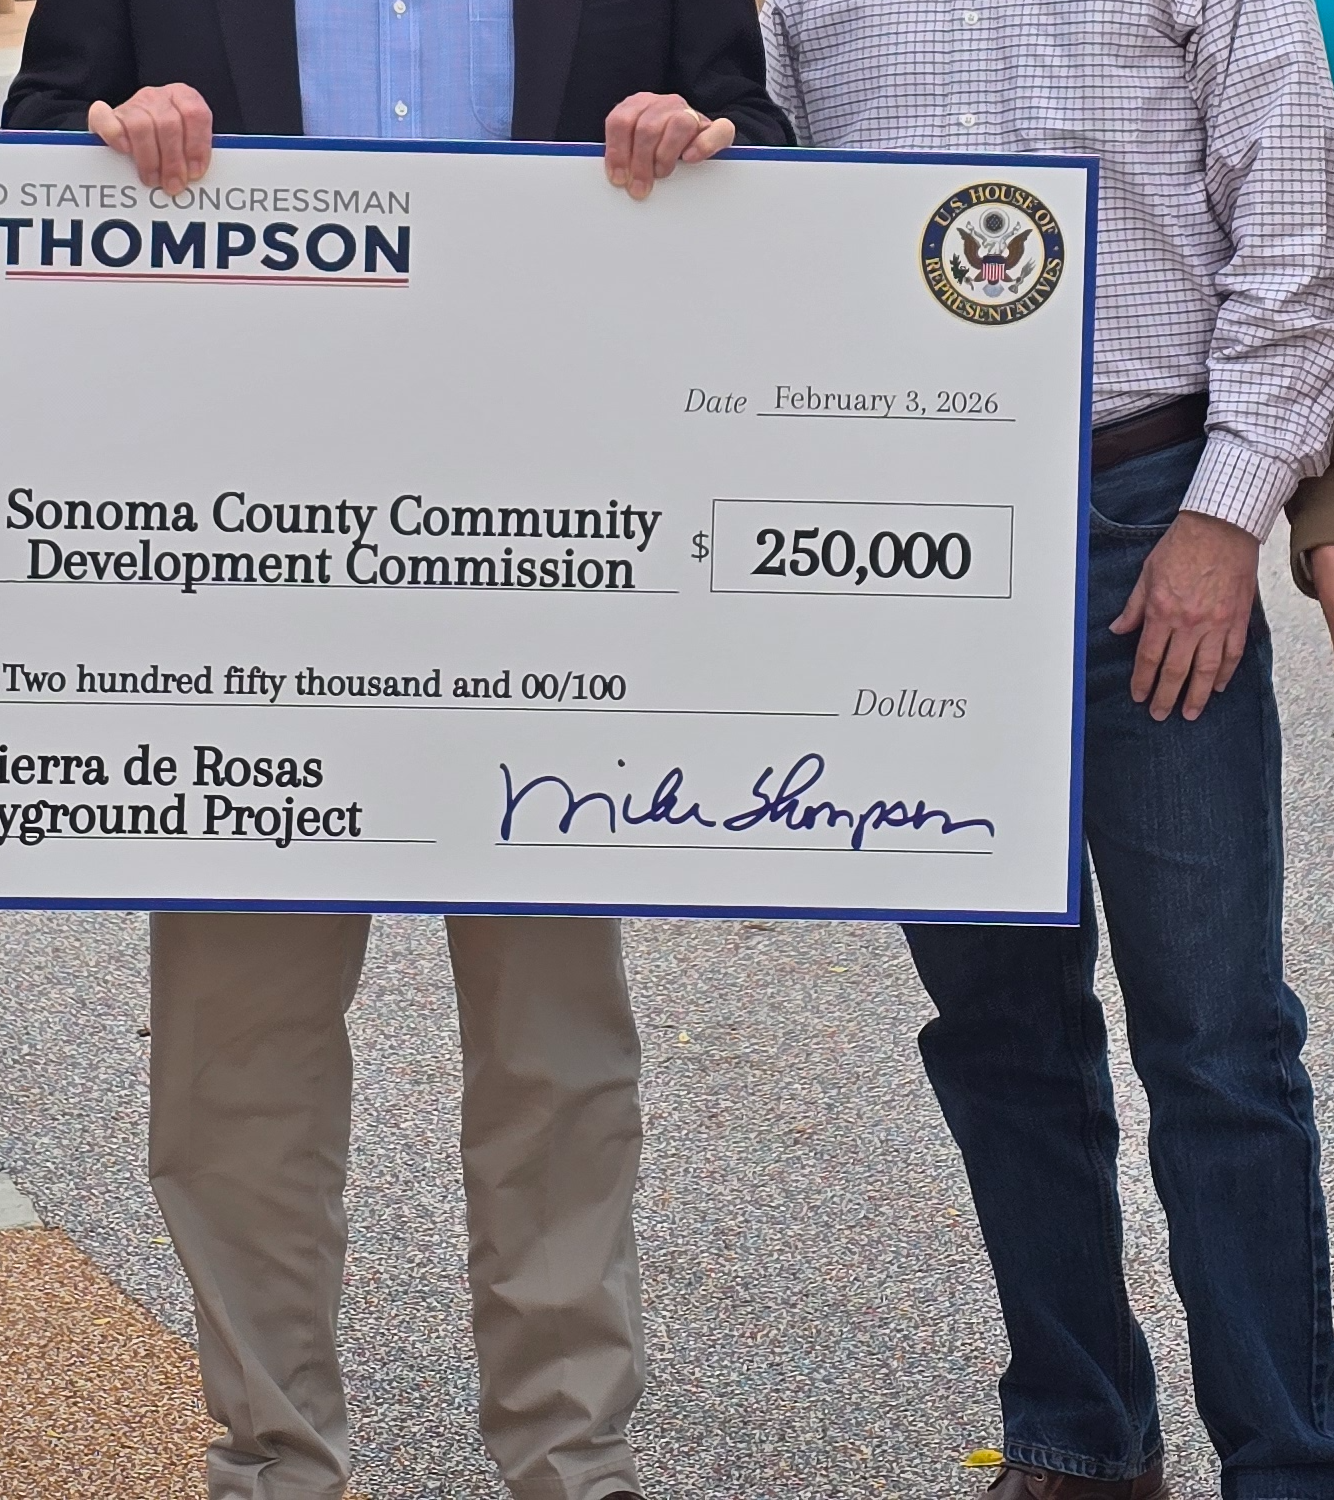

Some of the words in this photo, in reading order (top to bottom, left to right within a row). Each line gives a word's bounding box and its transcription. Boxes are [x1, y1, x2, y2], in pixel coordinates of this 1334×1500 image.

[20, 183, 139, 209] STATES
[151, 187, 411, 215] CONGRESSMAN
[934, 197, 967, 227] U.S.
[969, 185, 1039, 213] HOUSE
[1035, 209, 1058, 235] OF
[925, 257, 1062, 322] REPRESENTATIVES
[683, 387, 749, 415] Date
[774, 386, 896, 419] February
[905, 391, 928, 417] 3,
[936, 391, 1000, 414] 2026
[5, 487, 199, 533] Sonoma
[212, 491, 378, 547] County
[389, 494, 663, 551] Community
[26, 539, 331, 594] Development
[345, 544, 636, 590] Commission
[690, 531, 710, 562] $
[750, 527, 973, 586] 250,000
[2, 662, 67, 693] Two
[75, 663, 214, 695] hundred
[223, 665, 285, 704] fifty
[294, 666, 443, 699] thousand
[452, 669, 513, 701] and
[520, 671, 627, 703] 00/100
[851, 688, 968, 720] Dollars
[123, 744, 178, 787] de
[192, 746, 324, 789] Rosas
[201, 795, 363, 848] Project
